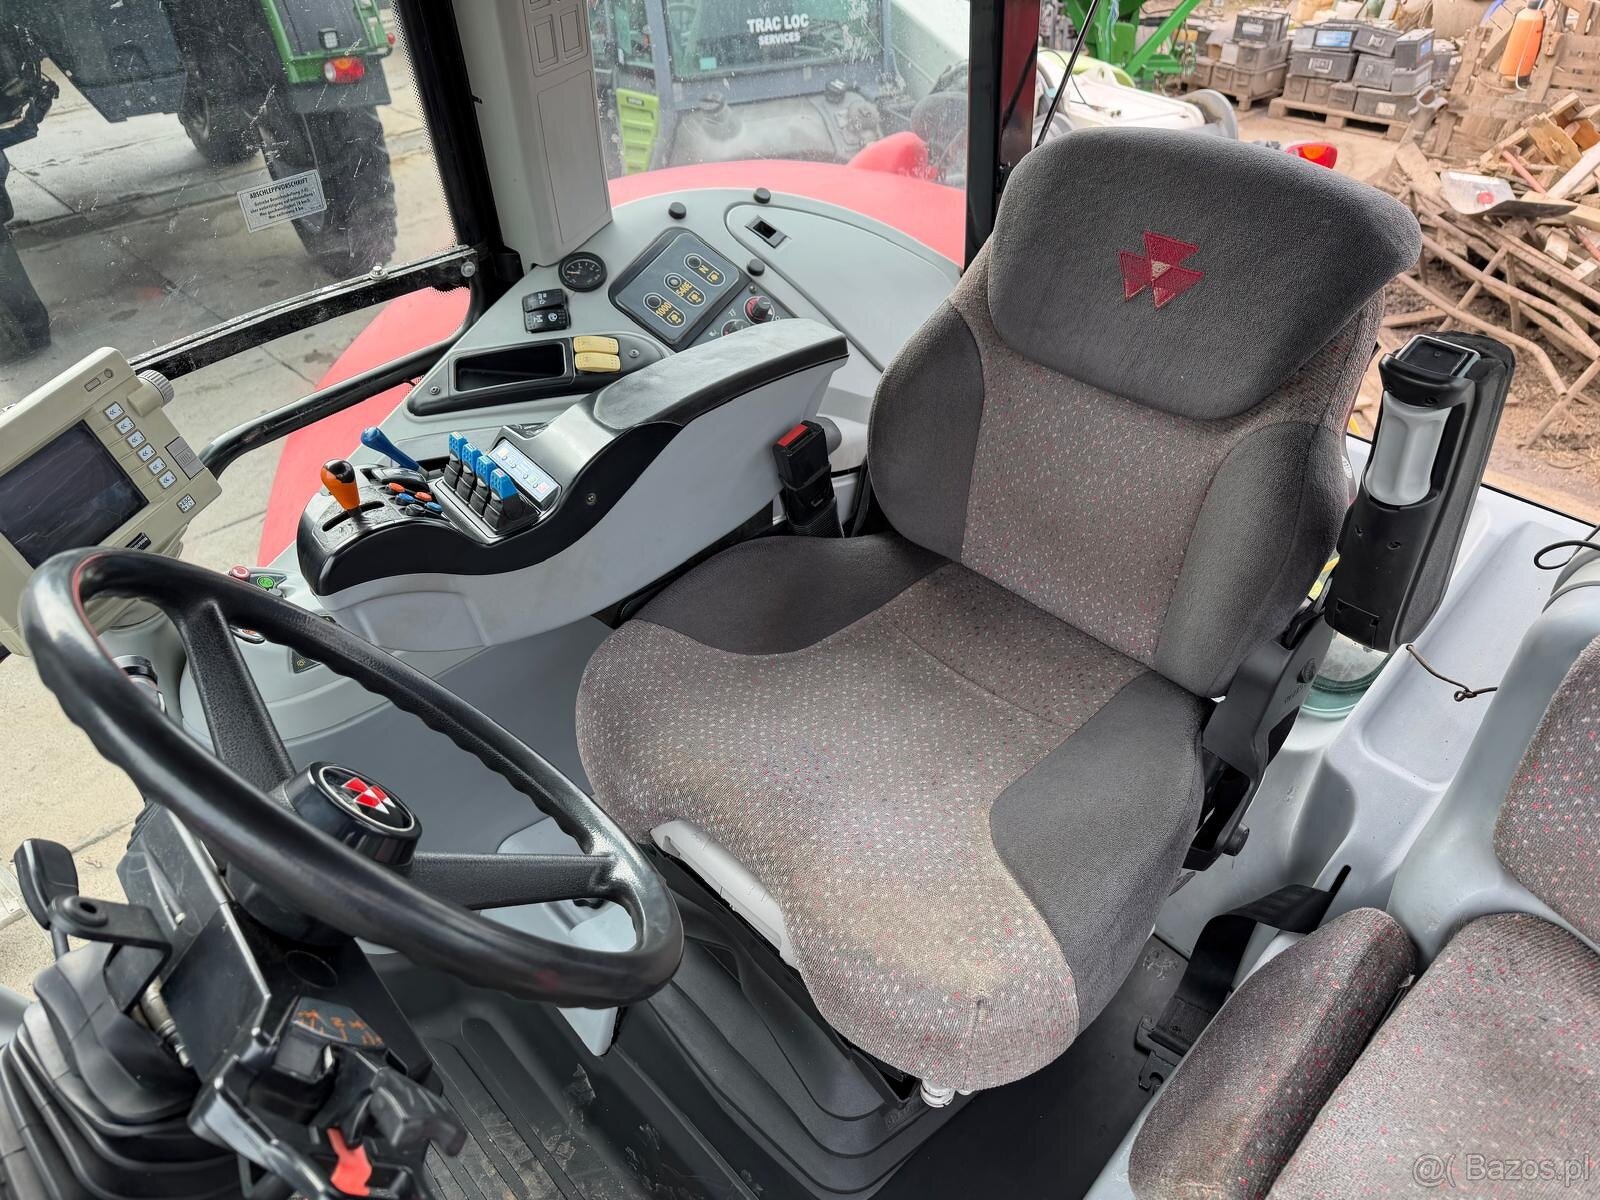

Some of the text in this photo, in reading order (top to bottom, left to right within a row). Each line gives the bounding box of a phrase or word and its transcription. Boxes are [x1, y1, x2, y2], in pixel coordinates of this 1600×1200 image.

[747, 13, 809, 34] TRAC LOC
[758, 31, 800, 46] SERVICES
[249, 177, 308, 199] ABSCHLEPPVORSCHRIFT
[675, 281, 692, 297] 540E
[655, 301, 672, 317] 1000
